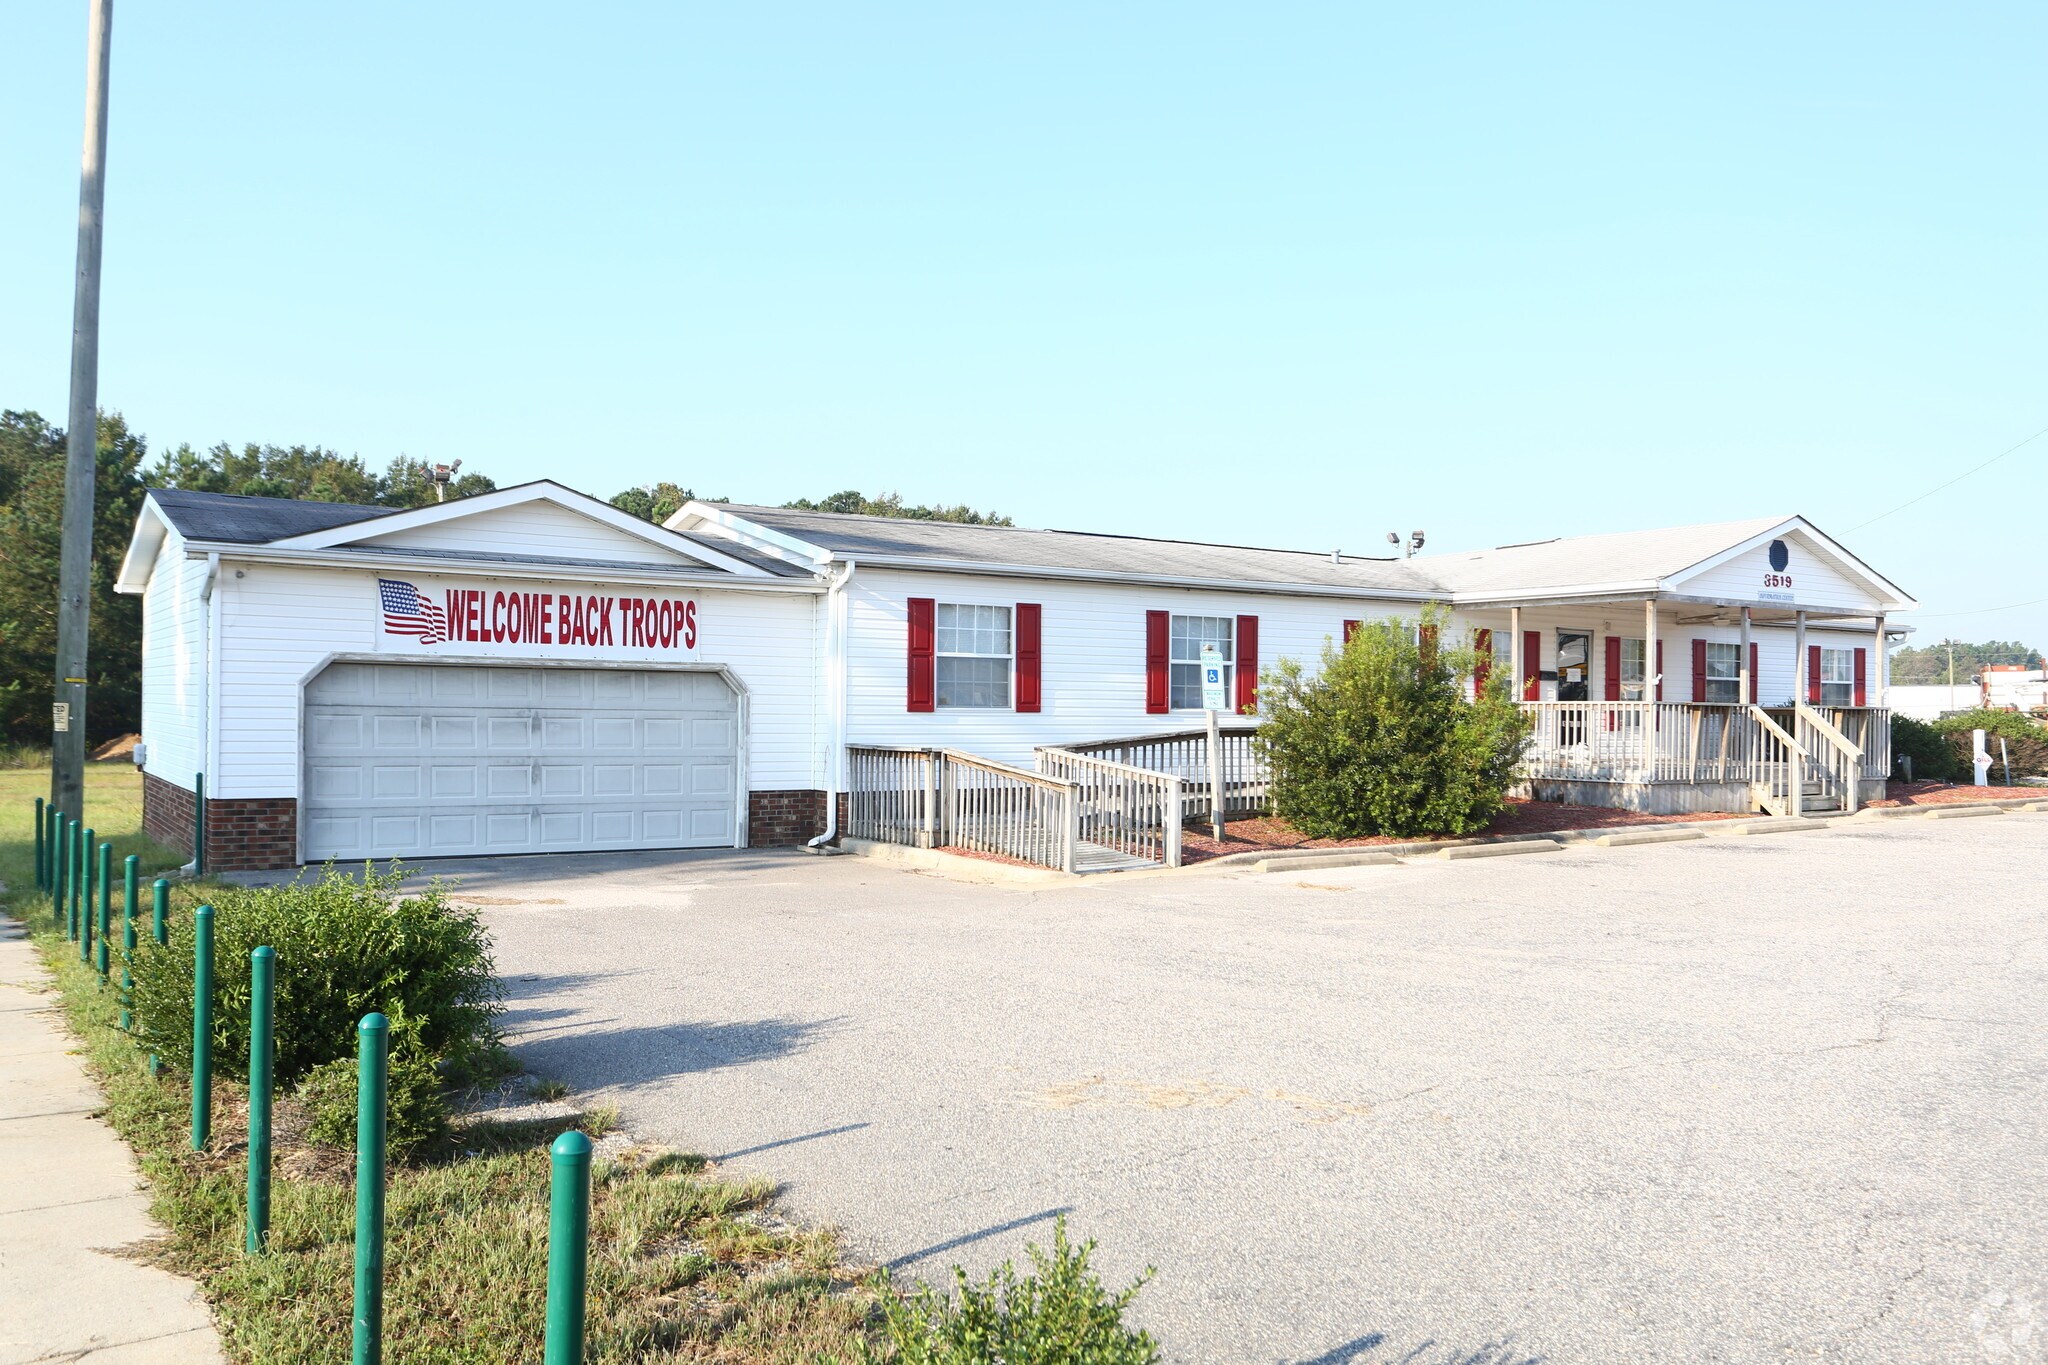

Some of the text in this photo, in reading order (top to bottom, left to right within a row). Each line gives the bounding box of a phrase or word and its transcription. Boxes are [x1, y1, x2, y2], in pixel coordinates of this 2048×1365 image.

[1764, 573, 1792, 588] 3519
[446, 588, 697, 650] WELCOME BACK TROOPS
